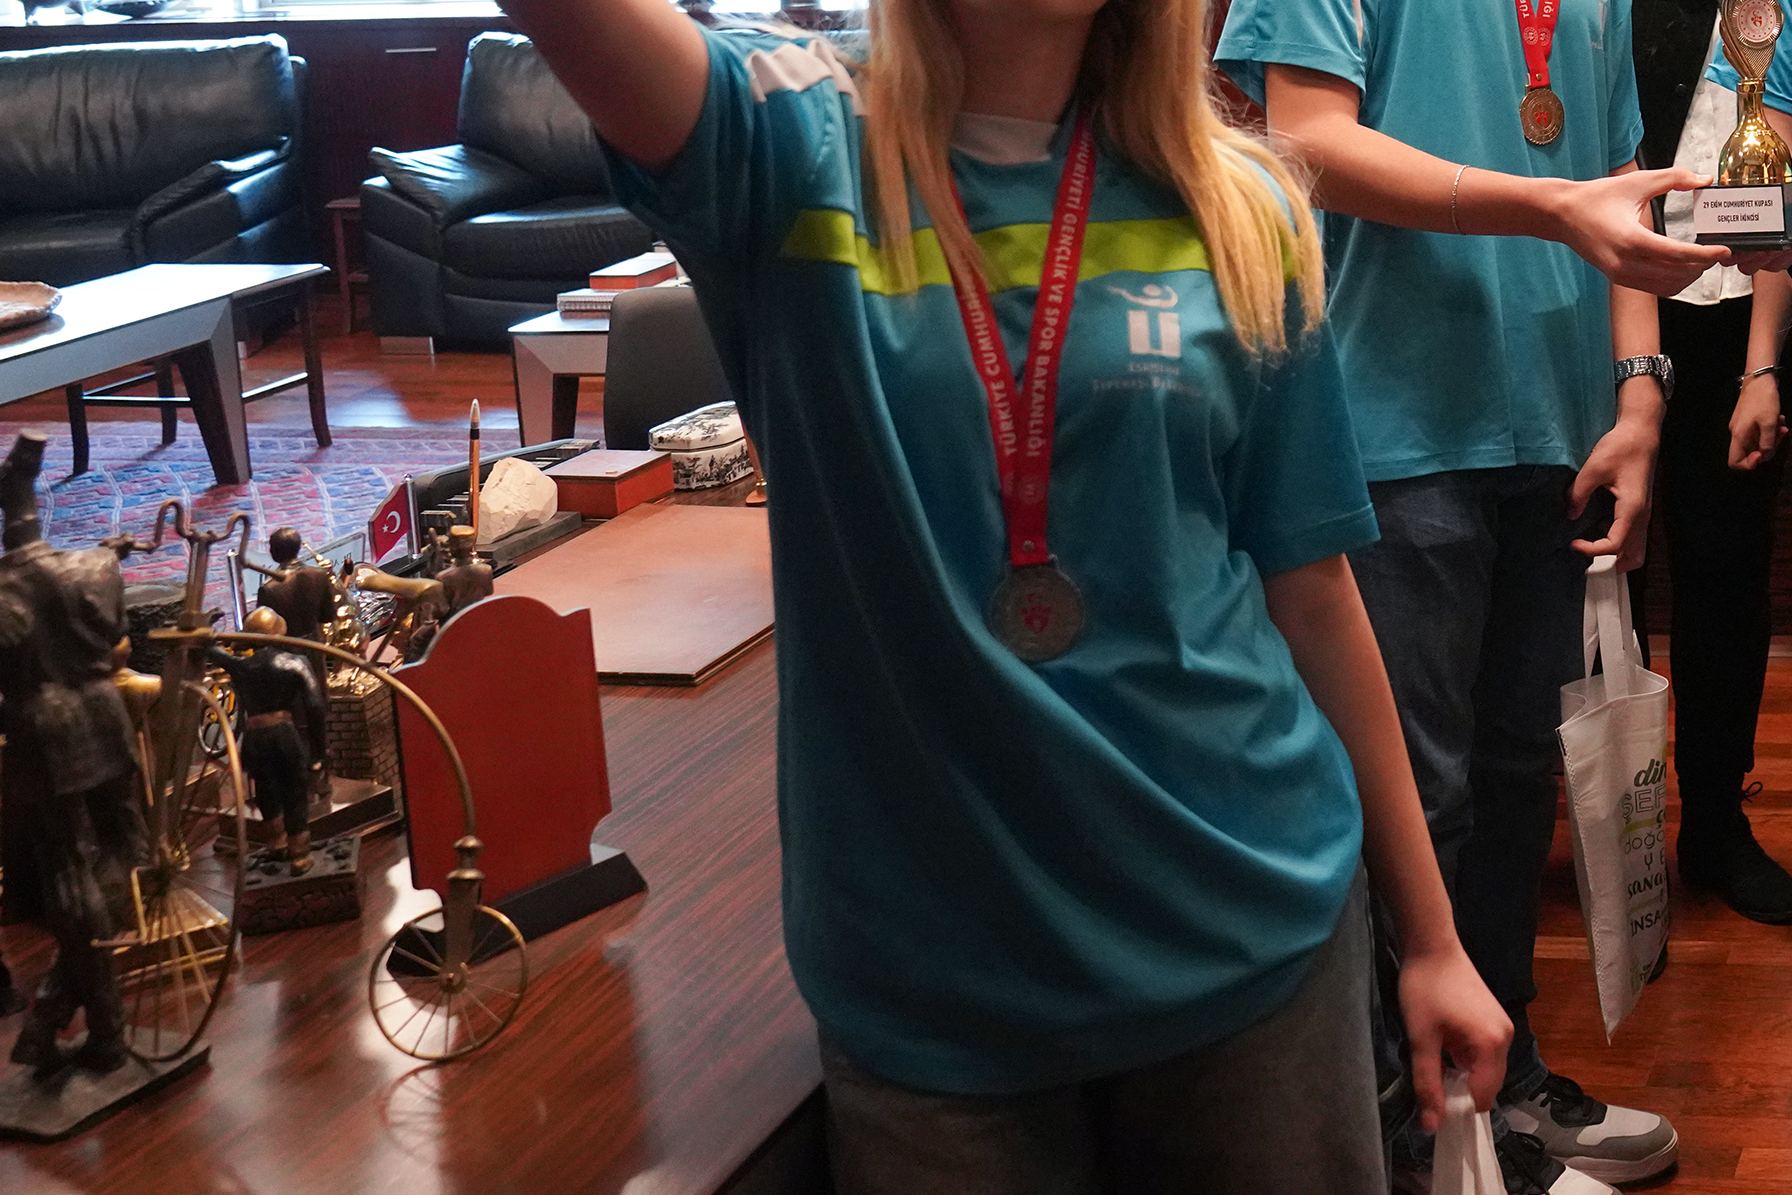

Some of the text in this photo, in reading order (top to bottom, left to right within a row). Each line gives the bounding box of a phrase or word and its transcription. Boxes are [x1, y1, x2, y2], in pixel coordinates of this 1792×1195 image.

[1717, 214, 1739, 223] GENÇLER
[1053, 213, 1078, 280] GENÇLİK
[1049, 284, 1065, 304] VE
[1038, 308, 1061, 351] SPOR
[1027, 356, 1050, 457] BAKANLIĞI
